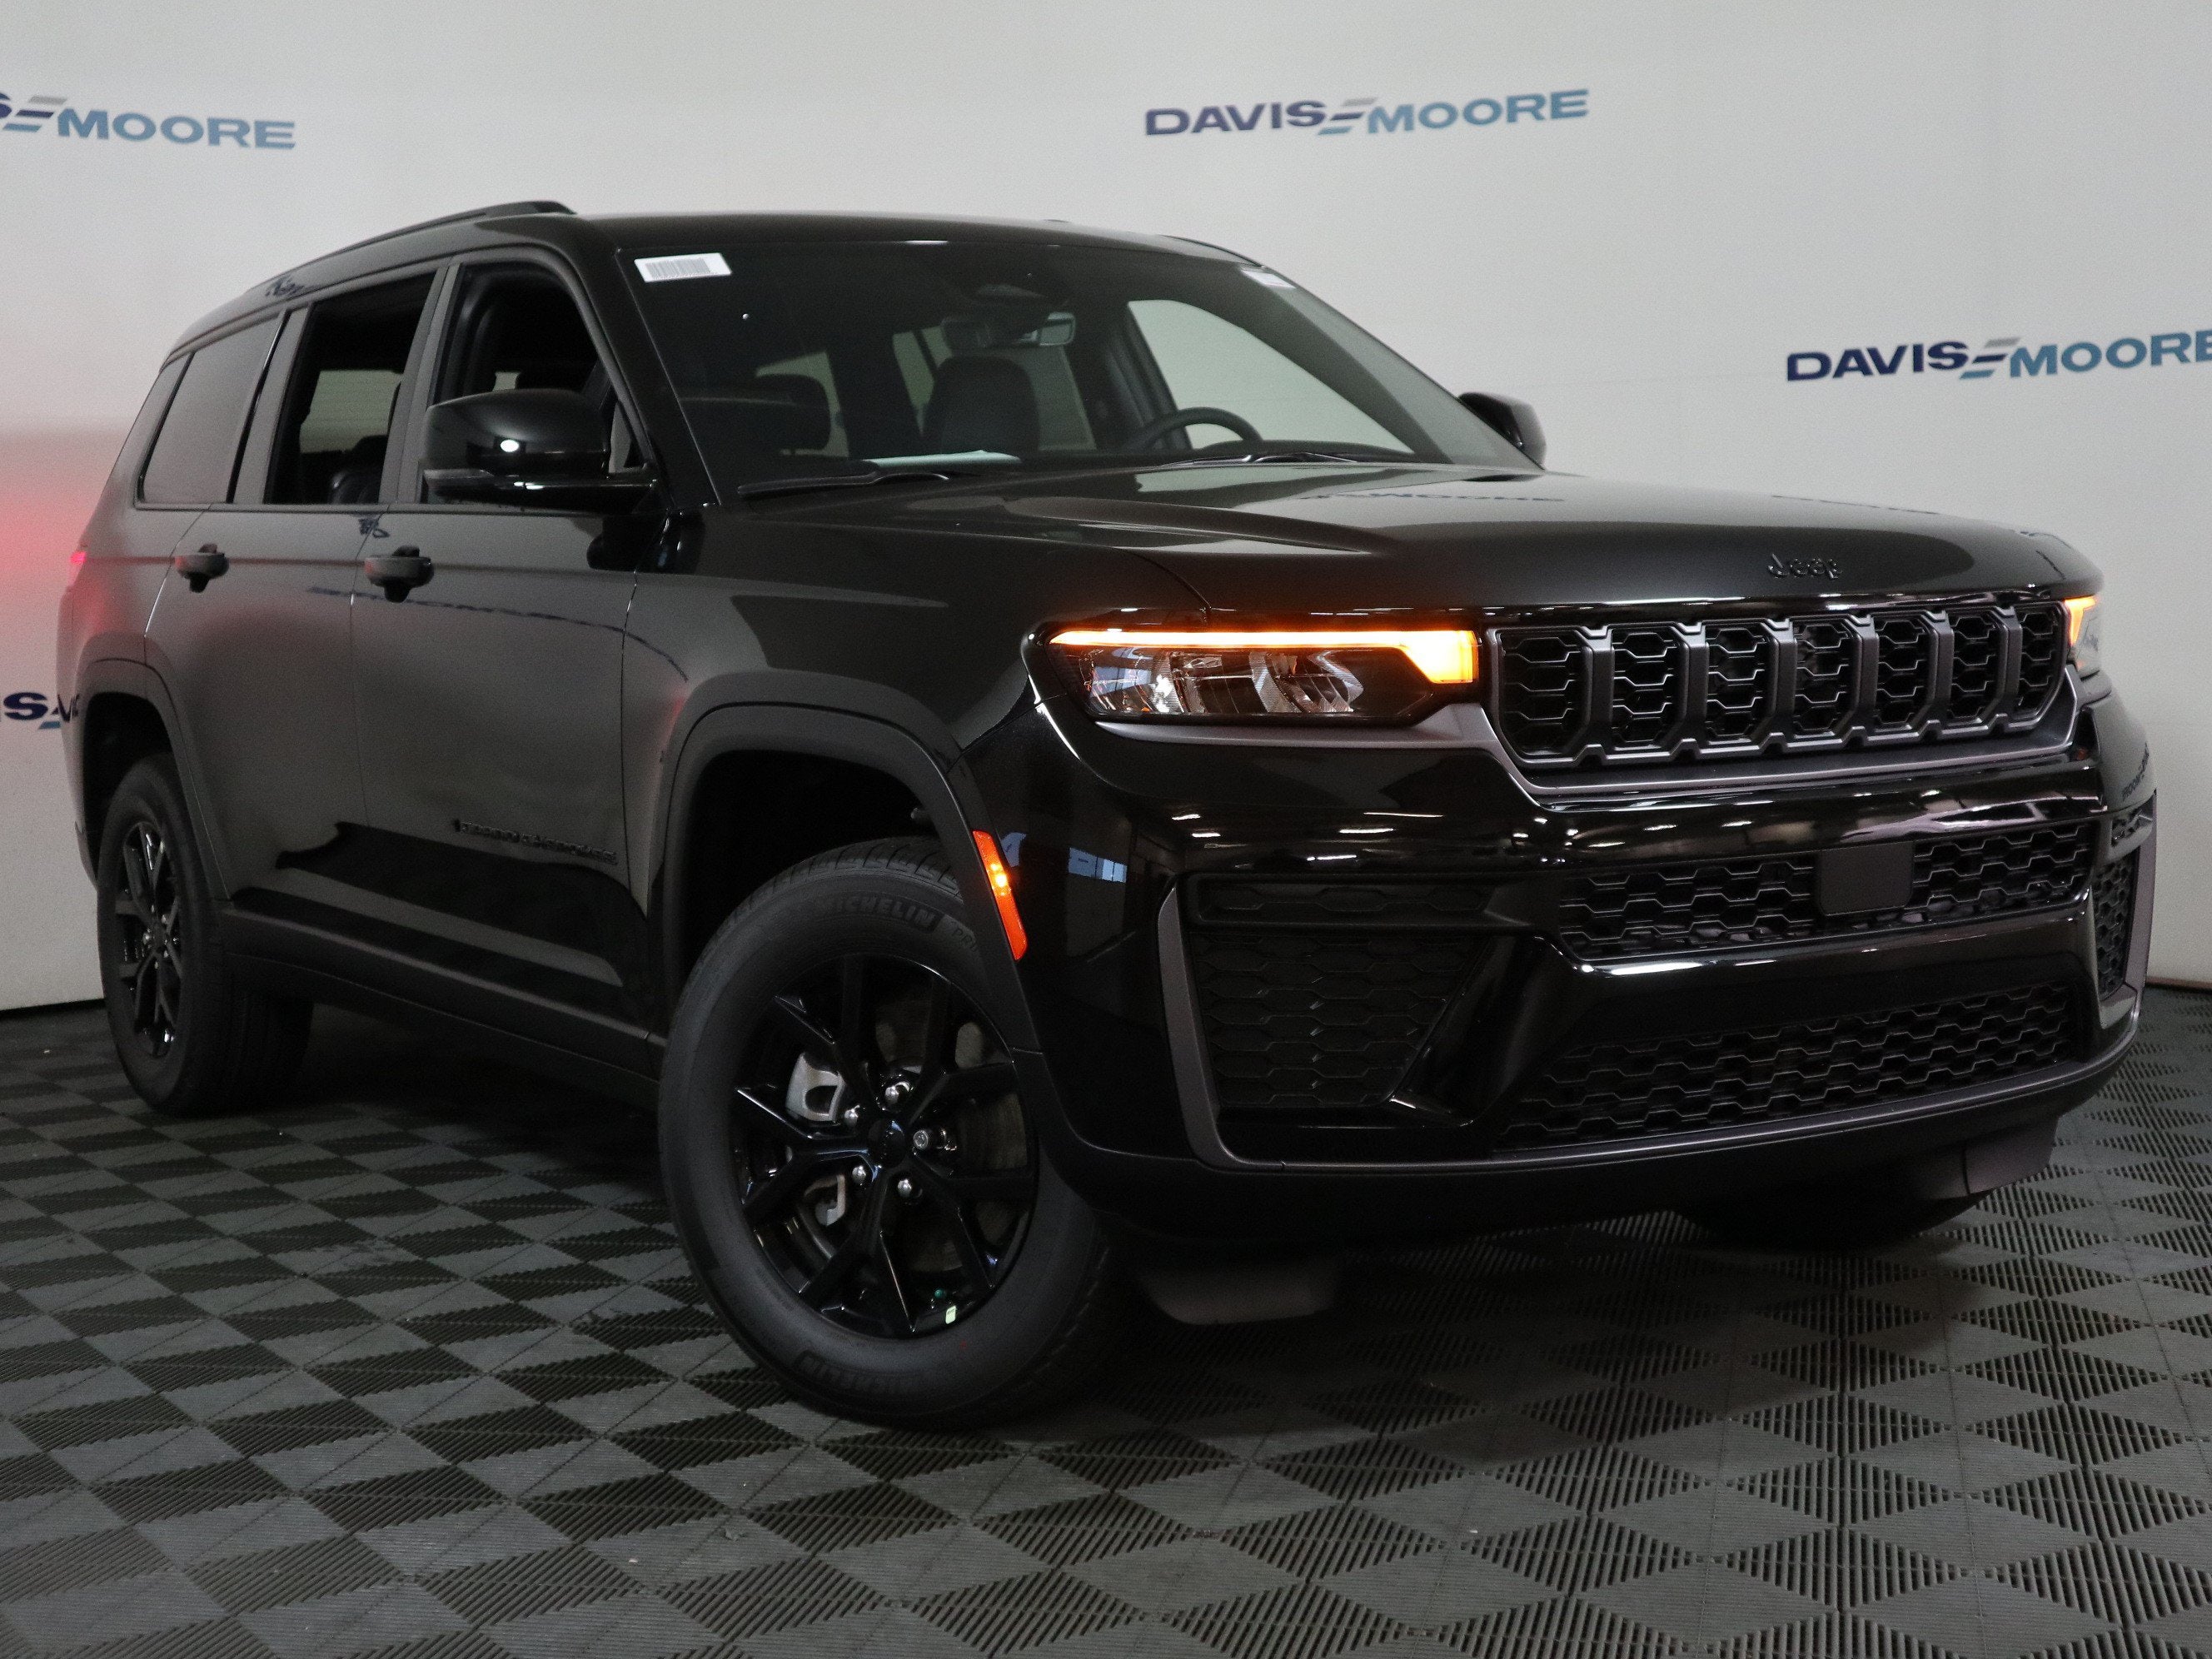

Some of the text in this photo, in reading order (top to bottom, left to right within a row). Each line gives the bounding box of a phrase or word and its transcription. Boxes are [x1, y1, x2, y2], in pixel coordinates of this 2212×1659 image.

[57, 107, 296, 150] MOORE
[1144, 89, 1590, 137] DAVIS MOORE
[1786, 341, 1970, 382] DAVIS
[1767, 553, 1844, 580] Jeep
